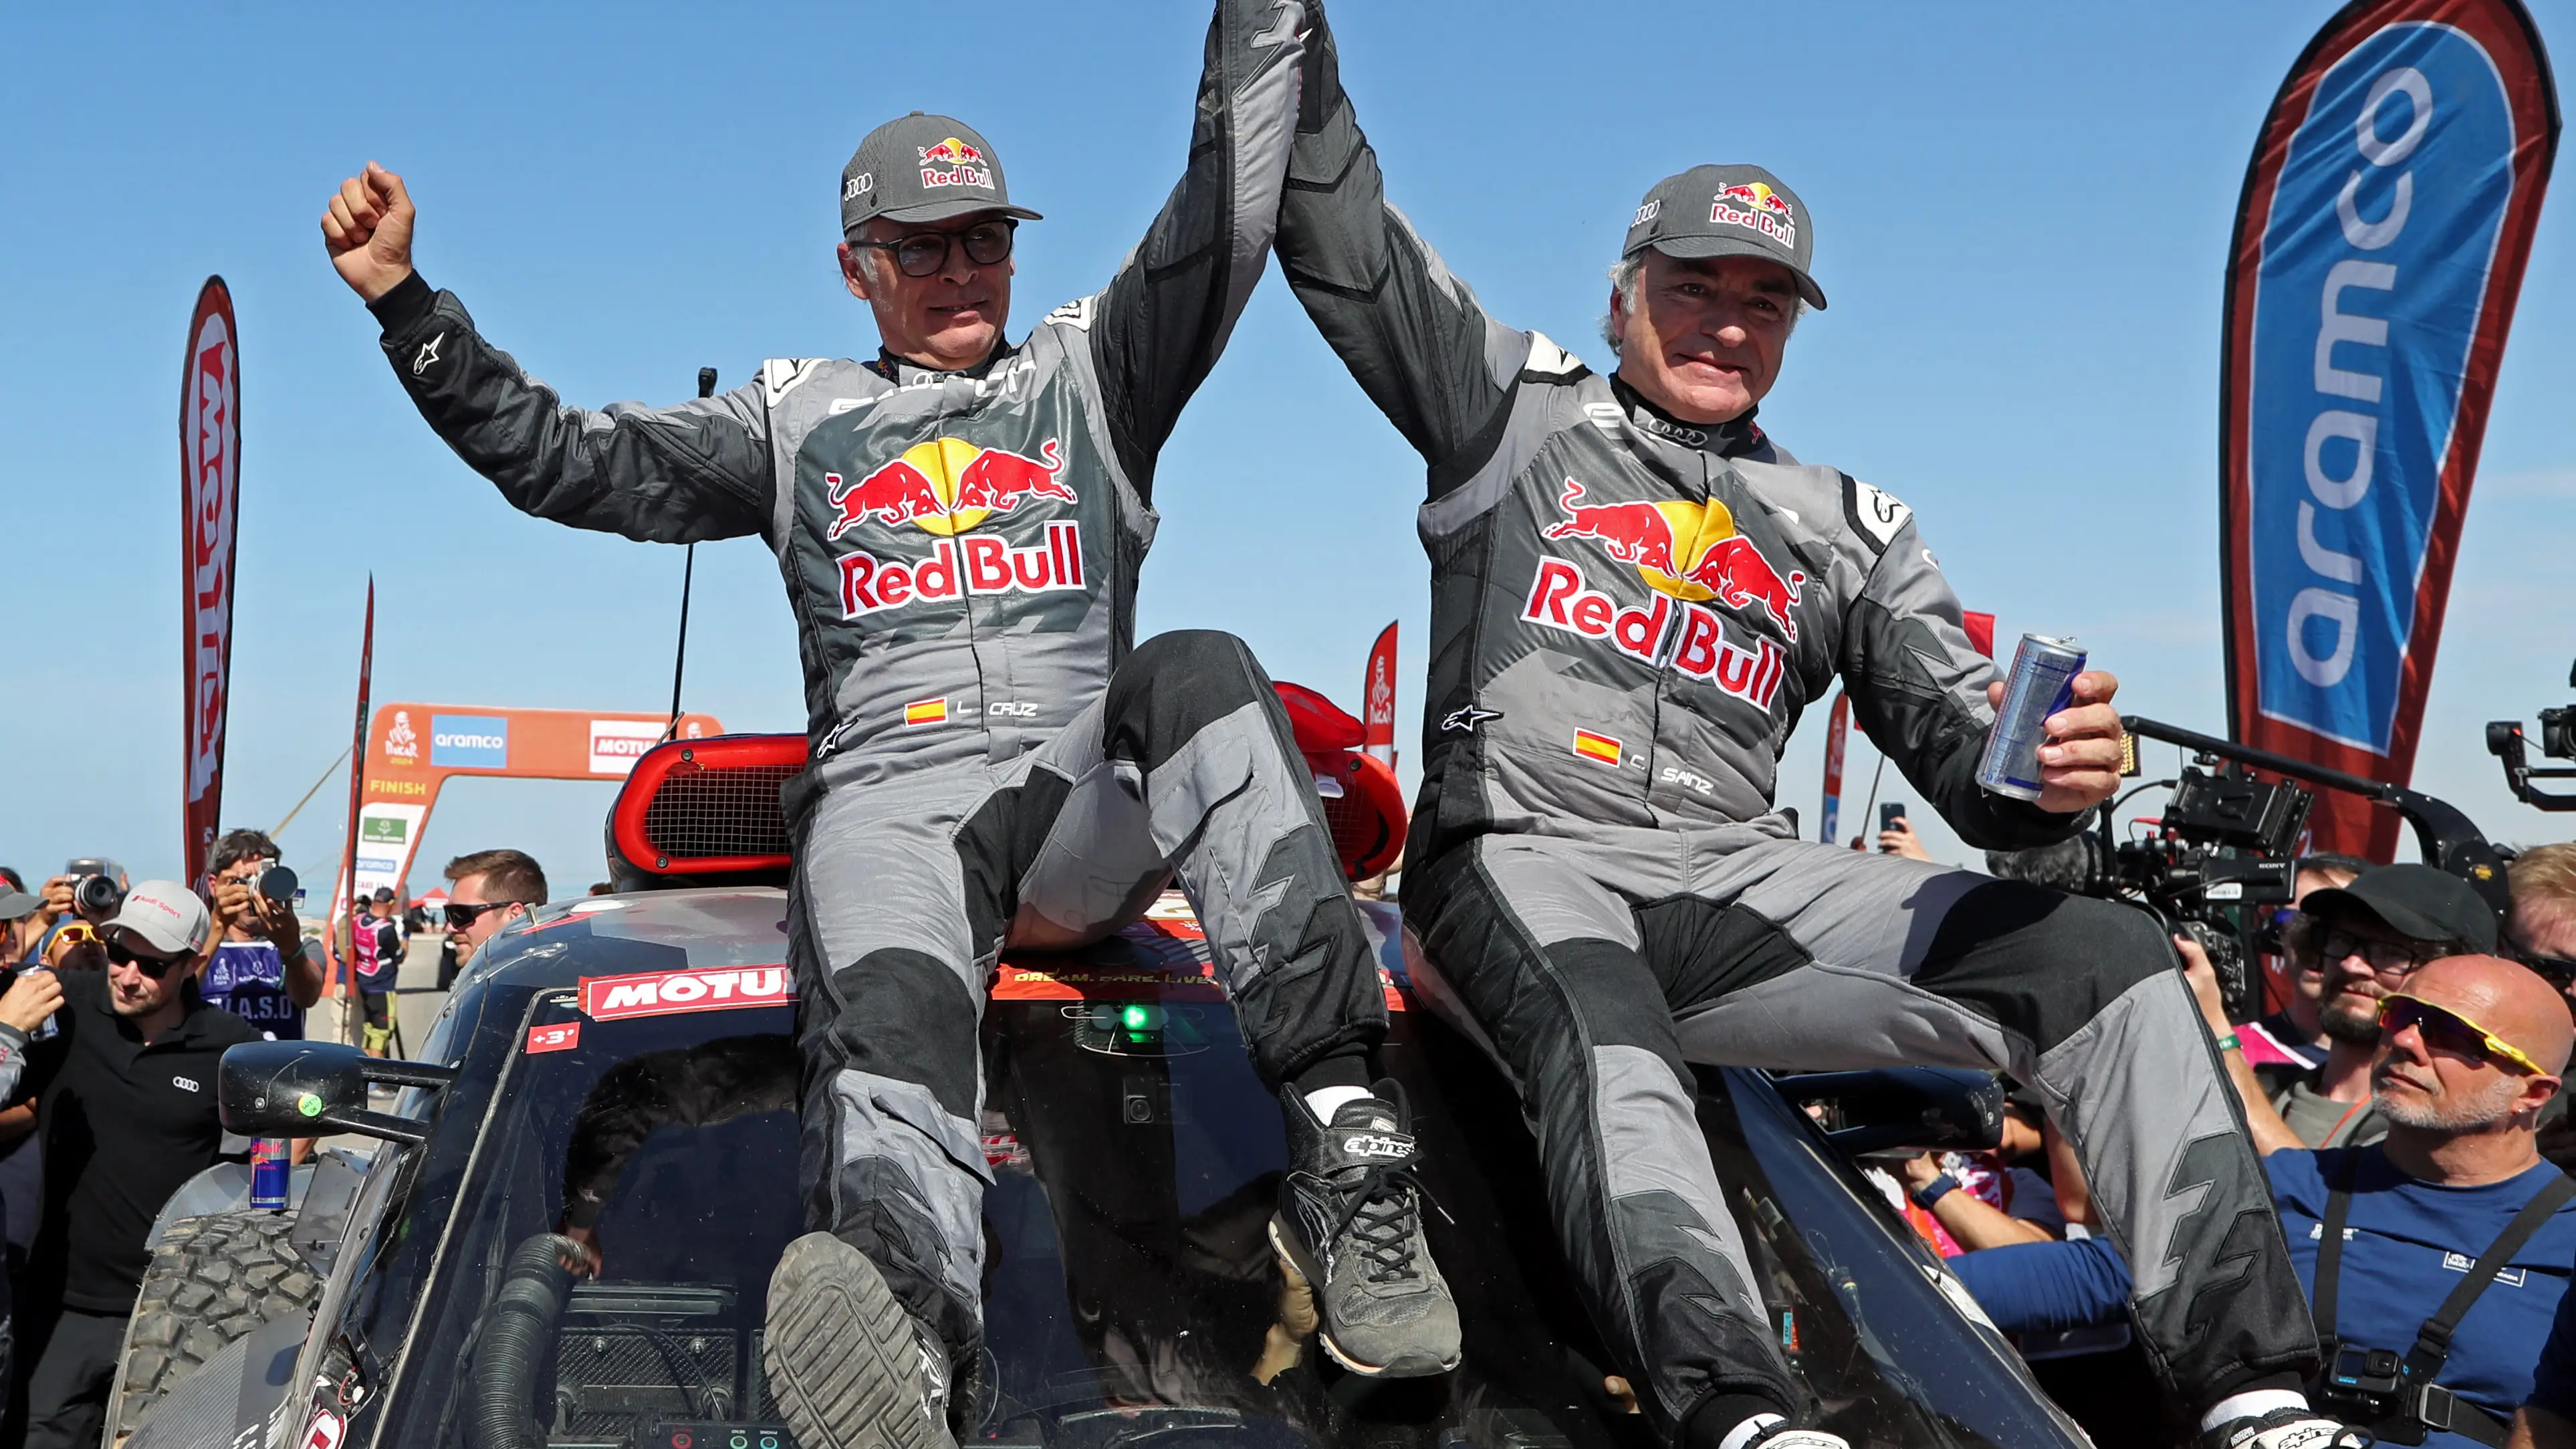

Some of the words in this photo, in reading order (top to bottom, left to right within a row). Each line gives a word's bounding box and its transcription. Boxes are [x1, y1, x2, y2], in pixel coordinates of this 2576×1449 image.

[922, 166, 961, 190] Red
[963, 166, 994, 189] Bull
[1710, 203, 1758, 230] Red
[1760, 214, 1794, 247] Bull
[2285, 65, 2433, 689] aramco
[838, 539, 961, 618] Red
[965, 522, 1084, 592] Bull
[1524, 558, 1671, 663] Red
[1673, 604, 1785, 711] Bull
[988, 701, 1039, 717] CRUZ
[435, 733, 504, 749] aramco
[596, 738, 659, 755] MOTU
[370, 779, 427, 795] FINISH
[158, 901, 181, 919] Sport
[601, 969, 794, 1010] MOTU
[2278, 1428, 2335, 1449] alpine
